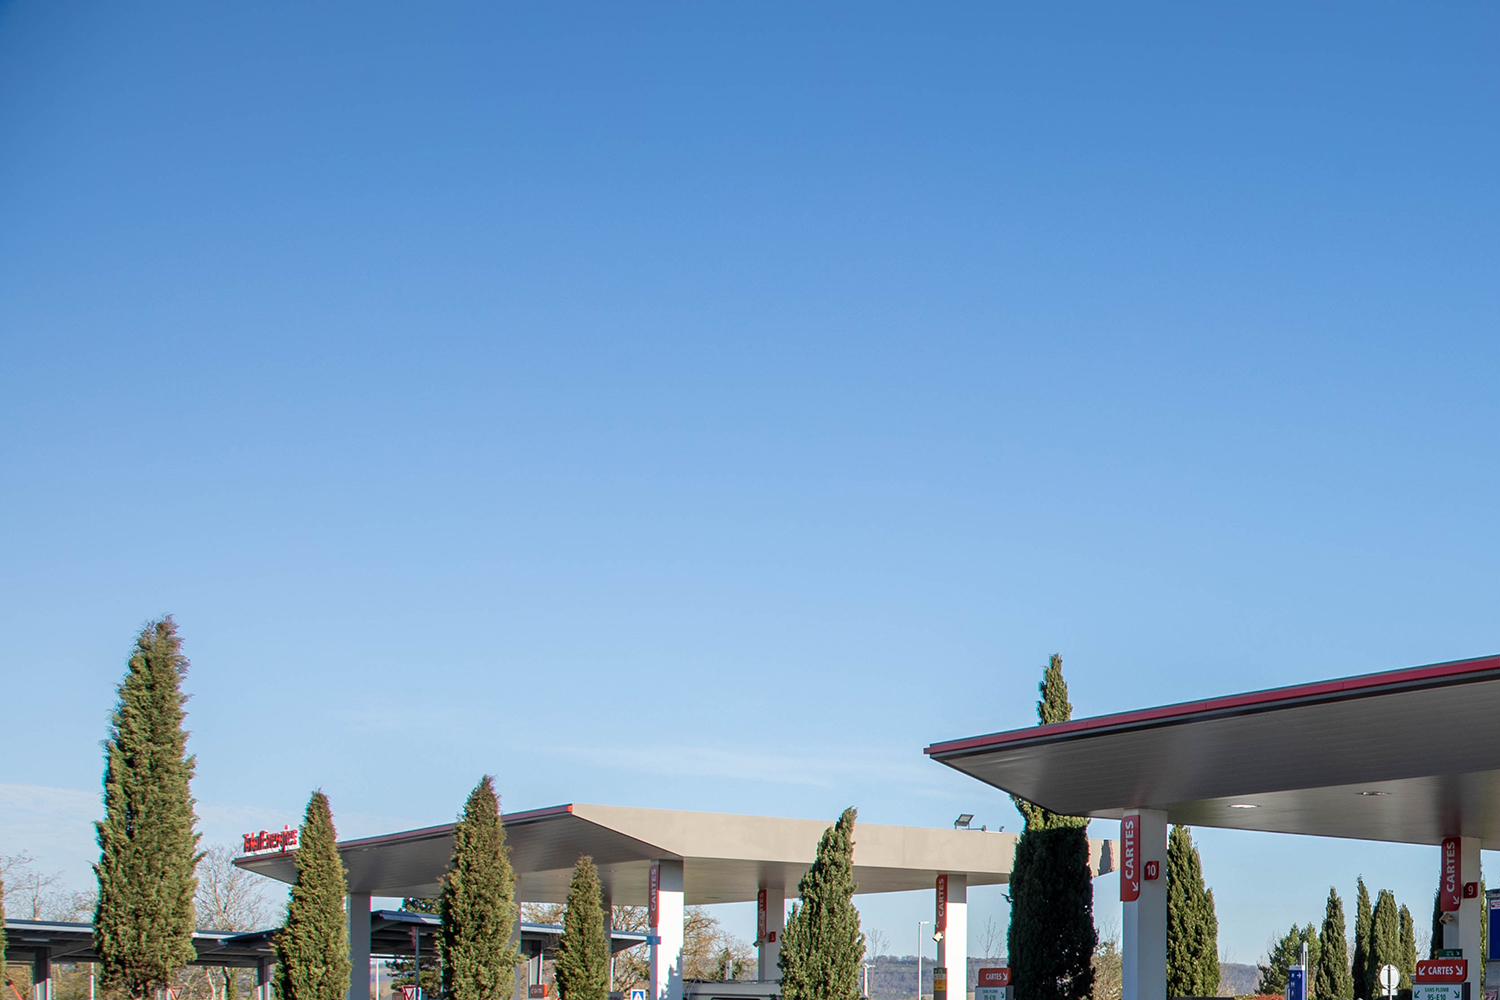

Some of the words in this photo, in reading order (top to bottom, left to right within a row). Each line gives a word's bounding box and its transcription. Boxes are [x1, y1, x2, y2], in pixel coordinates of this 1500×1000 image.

[1125, 820, 1134, 880] CARTES
[1146, 864, 1156, 876] 10
[1446, 841, 1455, 893] CARTES
[1467, 885, 1474, 895] 9
[1427, 966, 1454, 975] CARTES
[985, 972, 1002, 981] CARTES
